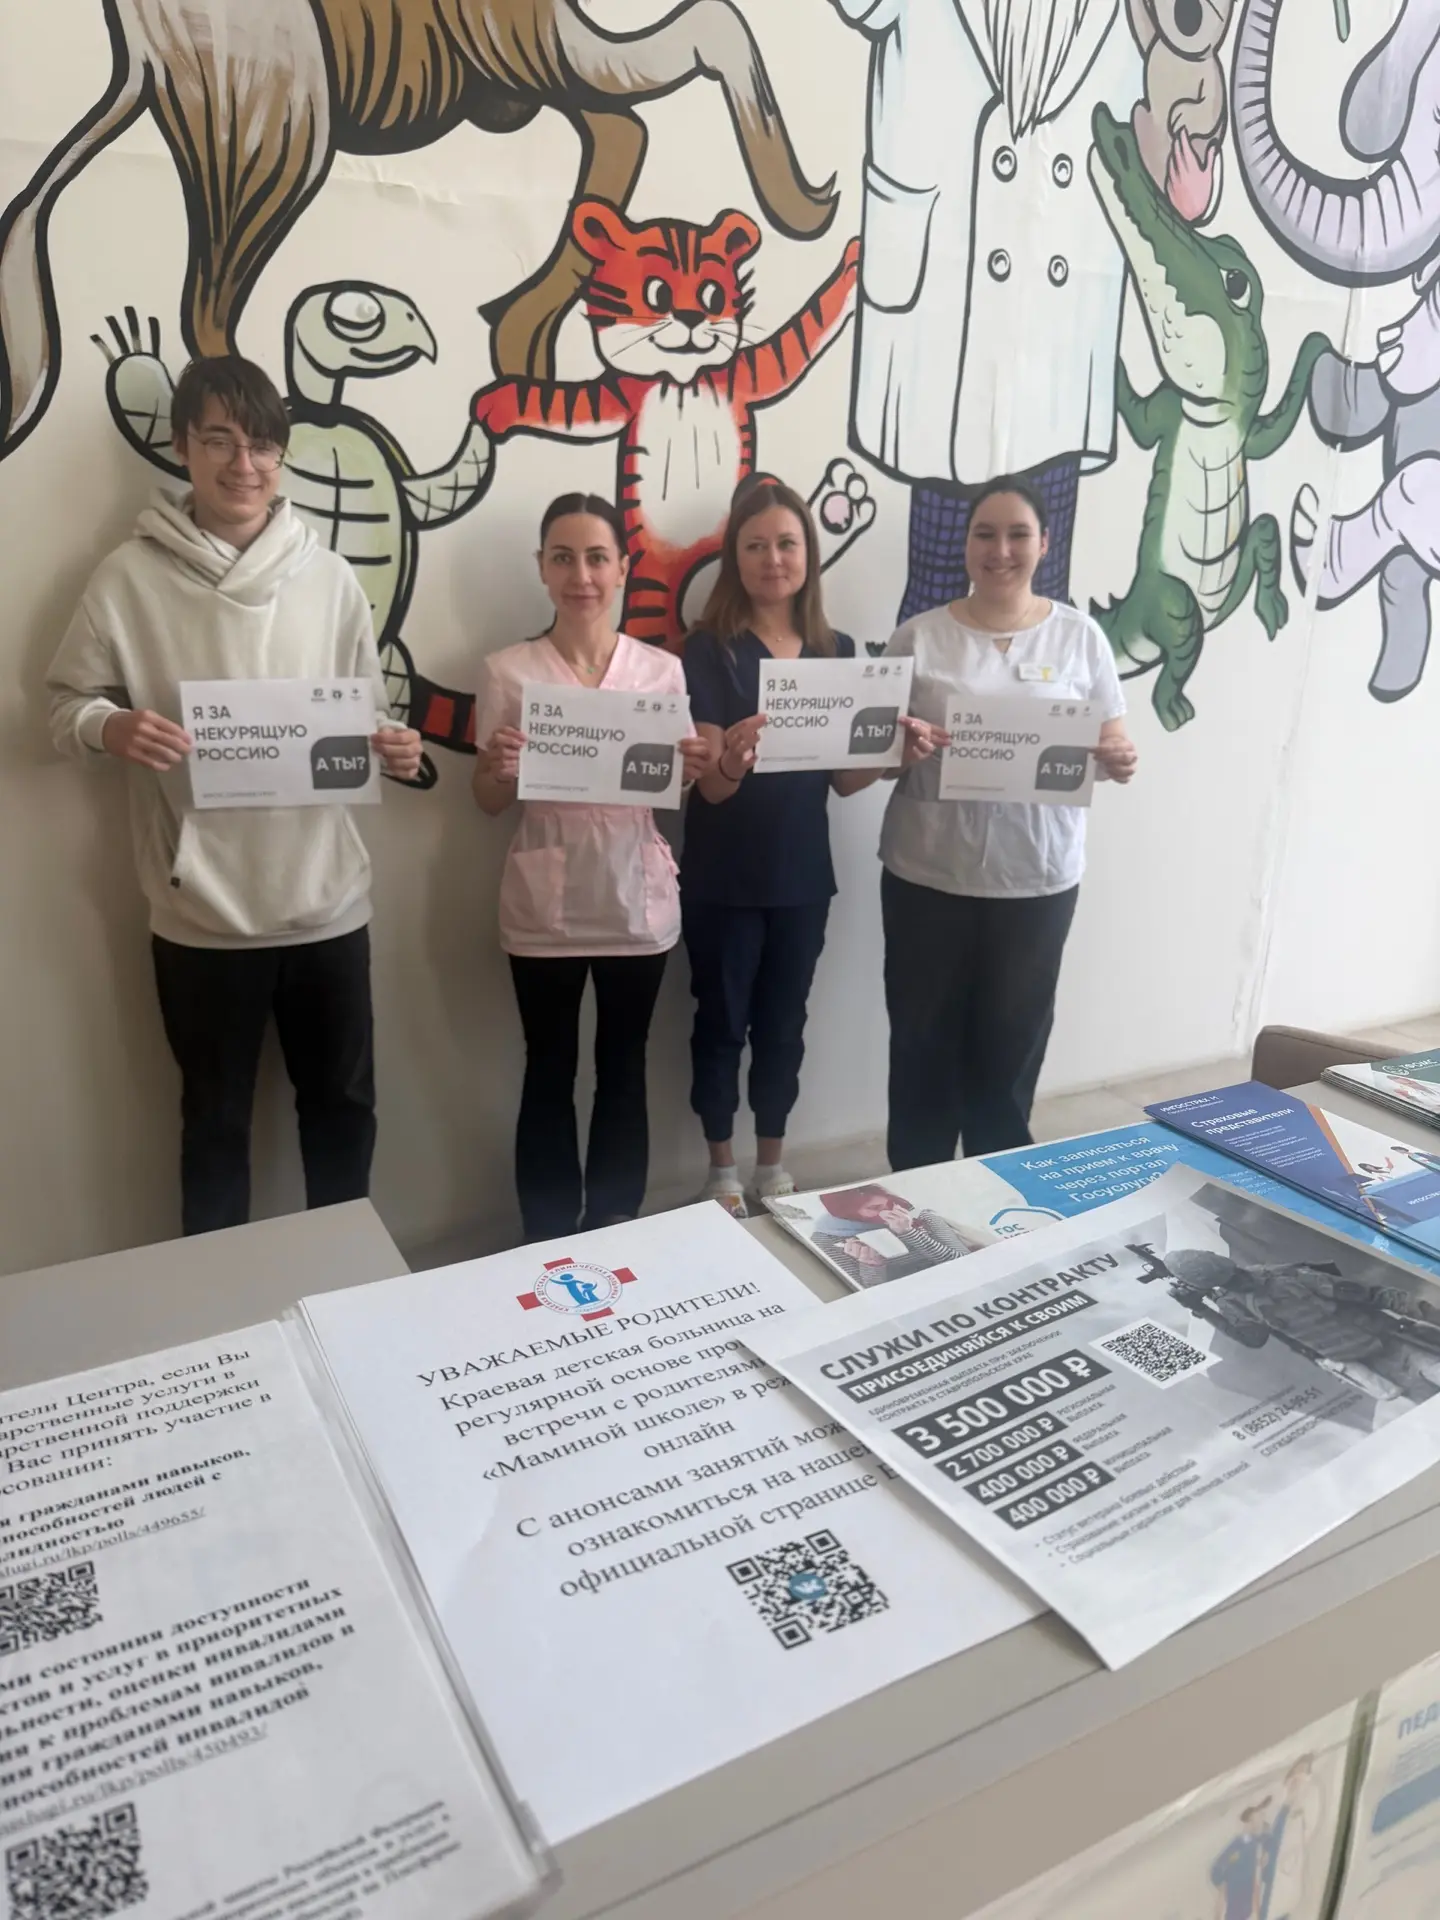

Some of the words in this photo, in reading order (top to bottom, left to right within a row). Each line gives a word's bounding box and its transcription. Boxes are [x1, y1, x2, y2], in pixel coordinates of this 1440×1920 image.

[766, 679, 776, 692] Я
[780, 679, 798, 692] ЗА
[766, 696, 854, 710] НЕКУРЯЩУЮ
[192, 706, 204, 719] Я
[209, 706, 231, 719] ЗА
[530, 703, 540, 716] Я
[544, 704, 563, 717] ЗА
[764, 716, 828, 728] РОССИЮ
[854, 726, 864, 738] А
[867, 724, 893, 737] ТЫ?
[952, 713, 961, 724] Я
[965, 714, 982, 725] ЗА
[195, 724, 307, 740] НЕКУРЯЩУЮ
[528, 722, 625, 742] НЕКУРЯЩУЮ
[528, 742, 598, 758] РОССИЮ
[951, 730, 1040, 745] НЕКУРЯЩУЮ
[197, 746, 280, 761] РОССИЮ
[316, 758, 329, 771] А
[332, 756, 366, 771] ТЫ?
[626, 761, 637, 774] А
[640, 762, 670, 776] ТЫ?
[950, 748, 1014, 760] РОССИЮ
[1040, 762, 1050, 774] А
[1055, 763, 1082, 776] ТЫ?
[1191, 1108, 1258, 1128] Страховые
[1205, 1108, 1294, 1135] представители
[1021, 1157, 1052, 1172] Как
[1058, 1136, 1150, 1162] записаться
[1039, 1169, 1060, 1181] на
[1118, 1154, 1131, 1162] к
[1132, 1142, 1180, 1161] врачу
[1054, 1173, 1106, 1192] через
[1108, 1158, 1168, 1180] портал
[416, 1322, 614, 1387] УВАЖАЕМЫЕ
[616, 1282, 762, 1331] РОДИТЕЛИ!
[820, 1328, 933, 1380] СЛУЖИ
[930, 1313, 977, 1338] ПО
[972, 1252, 1120, 1320] КОНТРАКТУ
[440, 1372, 547, 1411] Краевая
[554, 1344, 644, 1380] детская
[648, 1313, 756, 1350] больница
[760, 1303, 786, 1318] на
[849, 1327, 1012, 1399] ПРИСОЕДИНЯЙСЯ
[1008, 1318, 1028, 1332] К
[1026, 1294, 1089, 1326] СВОИМ
[66, 1380, 156, 1408] Центра,
[161, 1362, 211, 1382] если
[216, 1350, 251, 1366] Вы
[140, 1376, 216, 1406] услуги
[224, 1370, 236, 1380] в
[454, 1380, 605, 1438] регулярной
[611, 1352, 693, 1386] основе
[868, 1379, 950, 1416] ЕДИНОВРЕМЕННАЯ
[949, 1362, 988, 1384] ВЫПЛАТА
[988, 1352, 1008, 1366] ПРИ
[876, 1398, 928, 1422] КОНТРАКТА
[936, 1362, 1012, 1399] СТАВРОПОЛЬСКОМ
[1012, 1352, 1034, 1365] КРАЕ
[136, 1380, 260, 1421] поддержки
[905, 1426, 941, 1452] 3
[936, 1397, 1008, 1438] 500
[1002, 1368, 1071, 1406] 000
[1063, 1356, 1091, 1380] ₽
[7, 1454, 53, 1474] Вас
[60, 1425, 158, 1460] принять
[165, 1398, 254, 1432] участие
[259, 1392, 272, 1403] в
[482, 1422, 630, 1482] «Маминой
[634, 1393, 726, 1432] школе»
[732, 1388, 748, 1400] в
[503, 1407, 608, 1447] встречи
[614, 1398, 628, 1411] с
[643, 1418, 736, 1460] онлайн
[946, 1460, 966, 1477] 2
[961, 1444, 1004, 1468] 700
[1002, 1425, 1040, 1449] 000
[0, 1456, 113, 1498] совании:
[18, 1476, 150, 1523] гражданами
[156, 1448, 252, 1484] навыков,
[142, 1474, 206, 1505] людей
[212, 1470, 222, 1482] с
[516, 1518, 542, 1538] С
[548, 1474, 684, 1532] анонсами
[686, 1436, 790, 1483] занятий
[978, 1472, 1018, 1499] 400
[1014, 1454, 1056, 1479] 000
[567, 1485, 758, 1558] ознакомиться
[763, 1468, 796, 1490] на
[1008, 1496, 1049, 1524] 400
[1046, 1476, 1088, 1502] 000
[559, 1518, 756, 1598] официальной
[760, 1474, 878, 1526] странице
[40, 1629, 165, 1680] состояния
[170, 1579, 312, 1638] доступности
[59, 1682, 74, 1696] и
[82, 1654, 150, 1690] услуг
[154, 1649, 170, 1662] в
[176, 1588, 344, 1655] приоритетных
[0, 1697, 102, 1740] ьности,
[108, 1662, 198, 1700] оценки
[204, 1606, 347, 1667] инвалидами
[38, 1734, 55, 1750] к
[62, 1682, 202, 1743] проблемам
[208, 1634, 336, 1688] инвалидов
[340, 1624, 356, 1638] и
[42, 1704, 202, 1772] гражданами
[208, 1661, 324, 1711] навыков,
